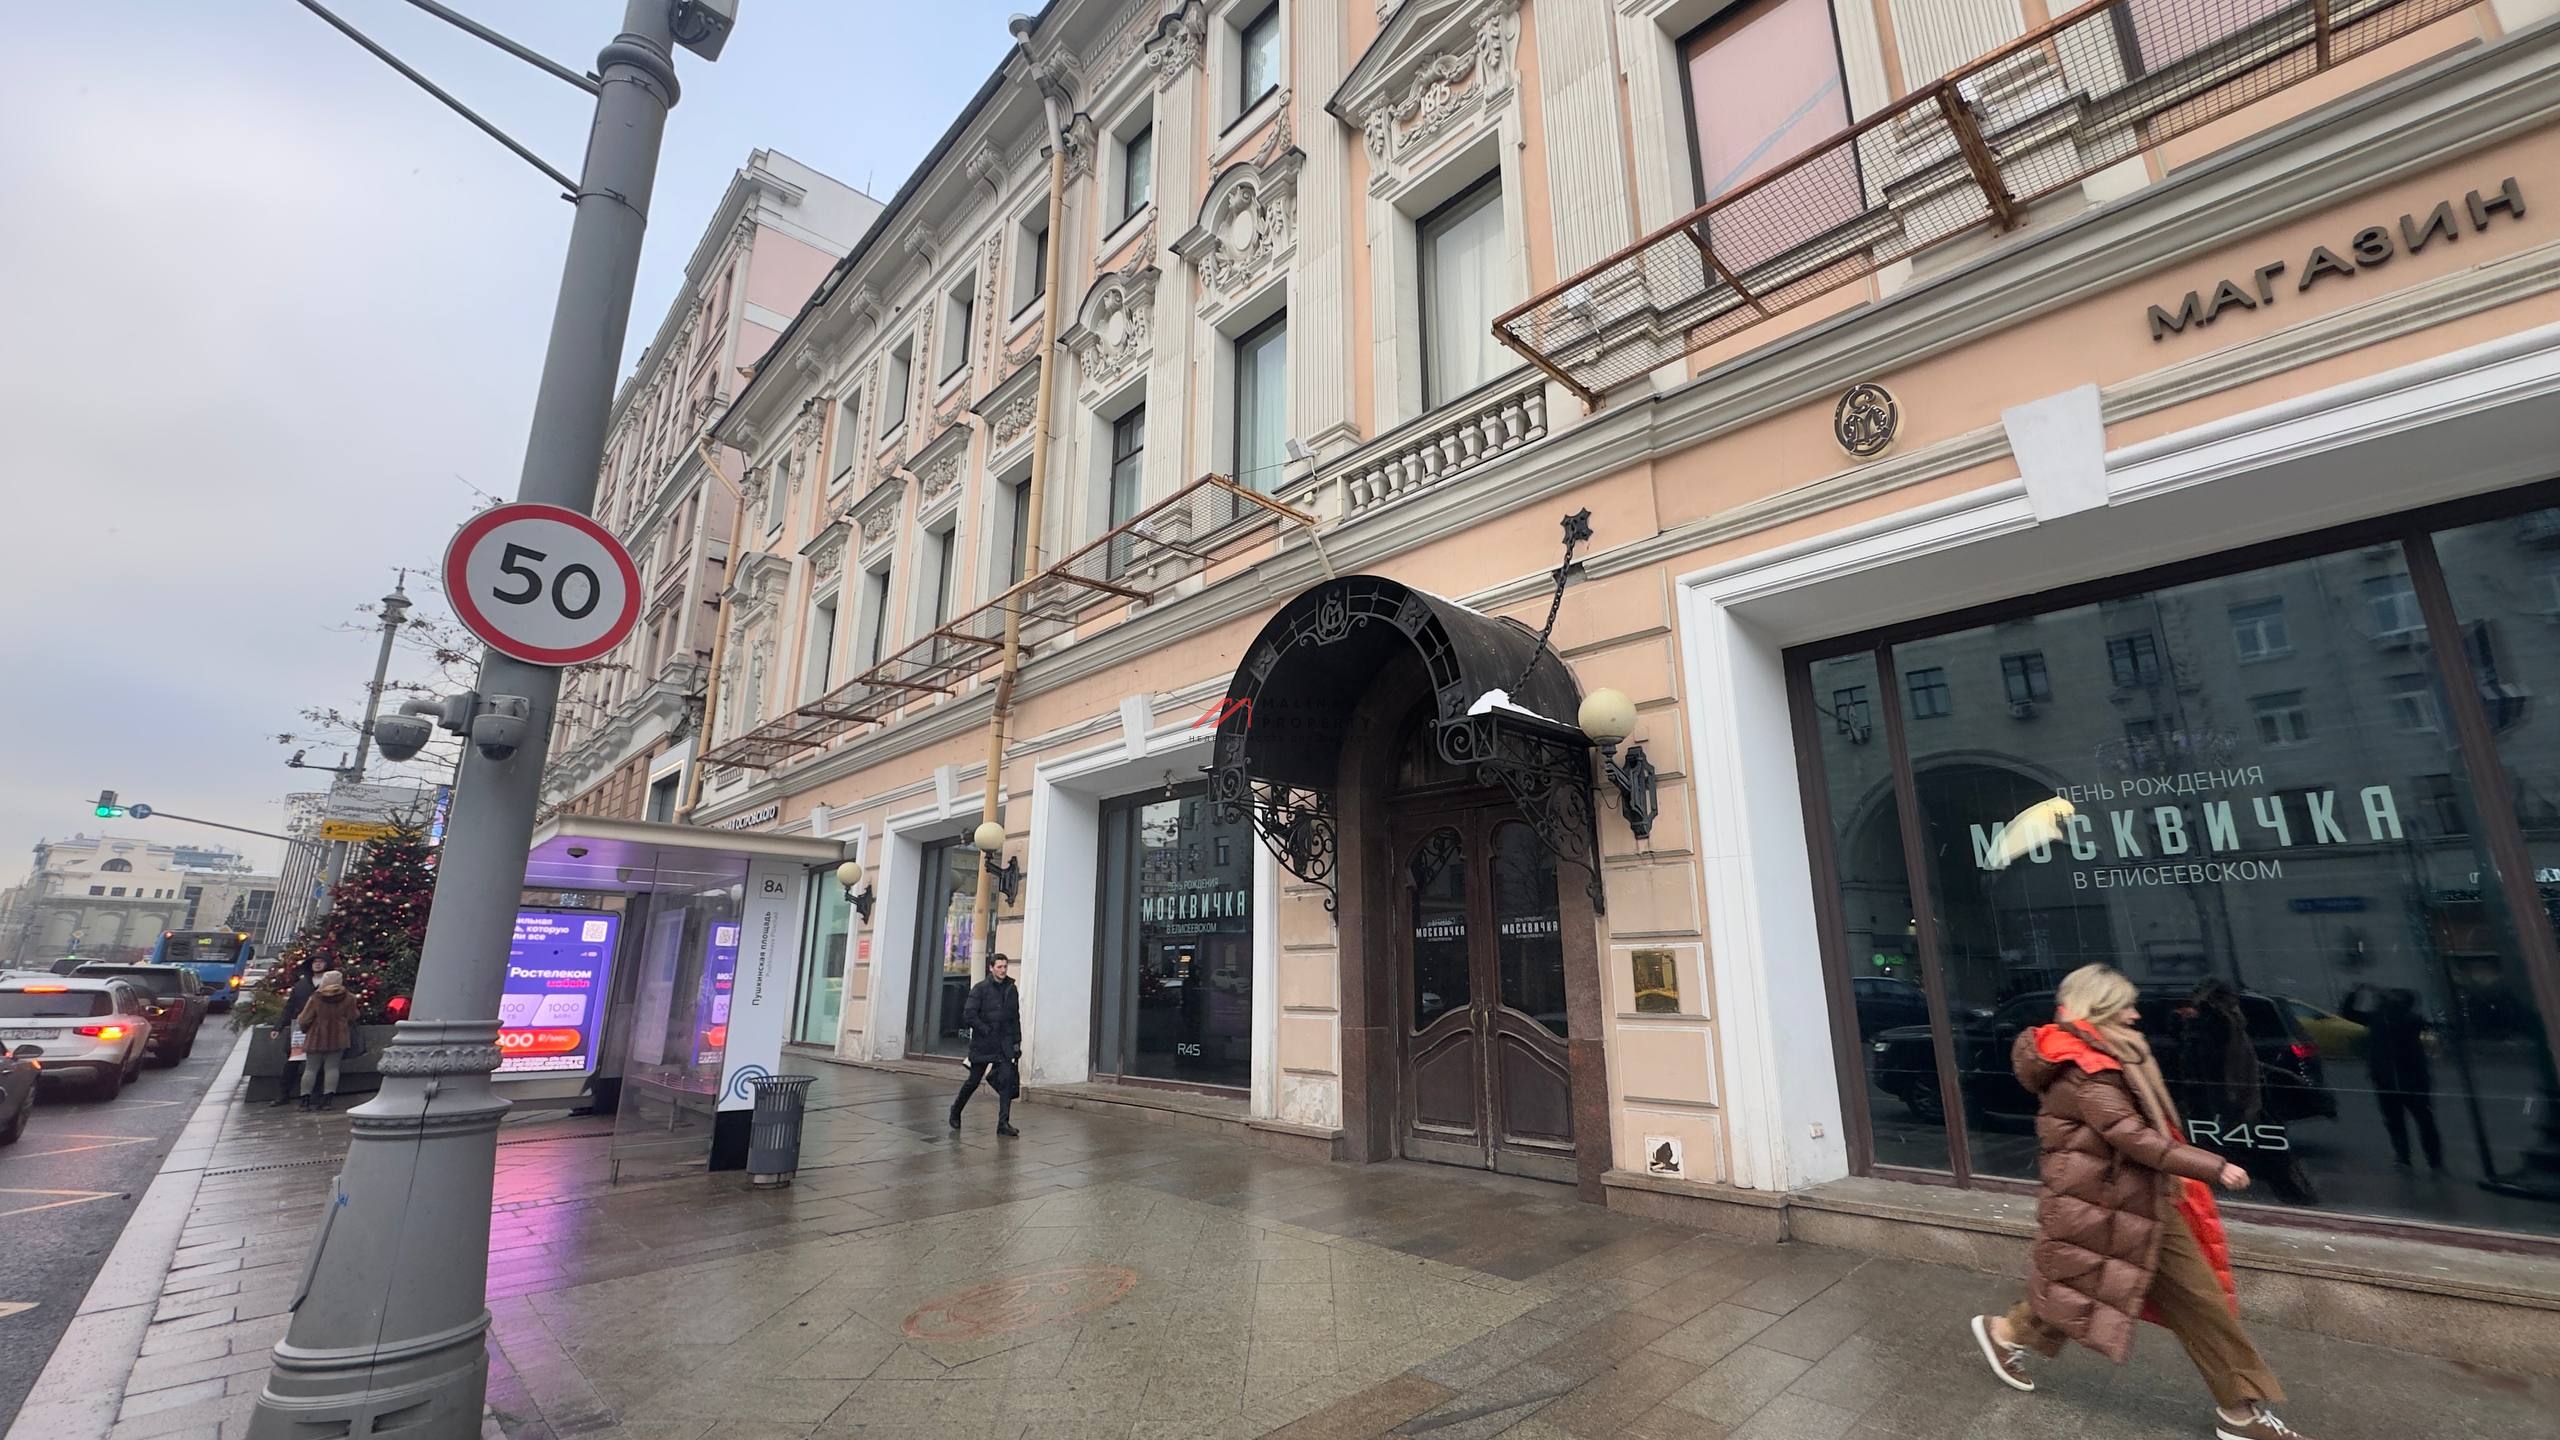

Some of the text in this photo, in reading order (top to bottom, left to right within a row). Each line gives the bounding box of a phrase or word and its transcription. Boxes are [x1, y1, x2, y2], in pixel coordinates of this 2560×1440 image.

[2147, 176, 2526, 341] МАГАЗИН
[493, 542, 600, 620] 50
[2121, 766, 2265, 798] РОЖДЕНИЯ
[1970, 785, 2404, 871] МОСКВИЧКА
[764, 880, 783, 893] 8А
[2074, 859, 2283, 890] В ЕЛИСЕЕВСКОМ
[1143, 890, 1245, 922] МОСКВИЧКА
[1416, 925, 1465, 938] МОСКВИЧКА
[1502, 921, 1558, 935] МОСКВИЧКА
[510, 967, 592, 978] Ростелеком
[752, 952, 766, 1006] Пушкинская
[548, 1003, 579, 1013] 1000
[1178, 1043, 1200, 1056] R4S
[2187, 1119, 2290, 1151] R4S
